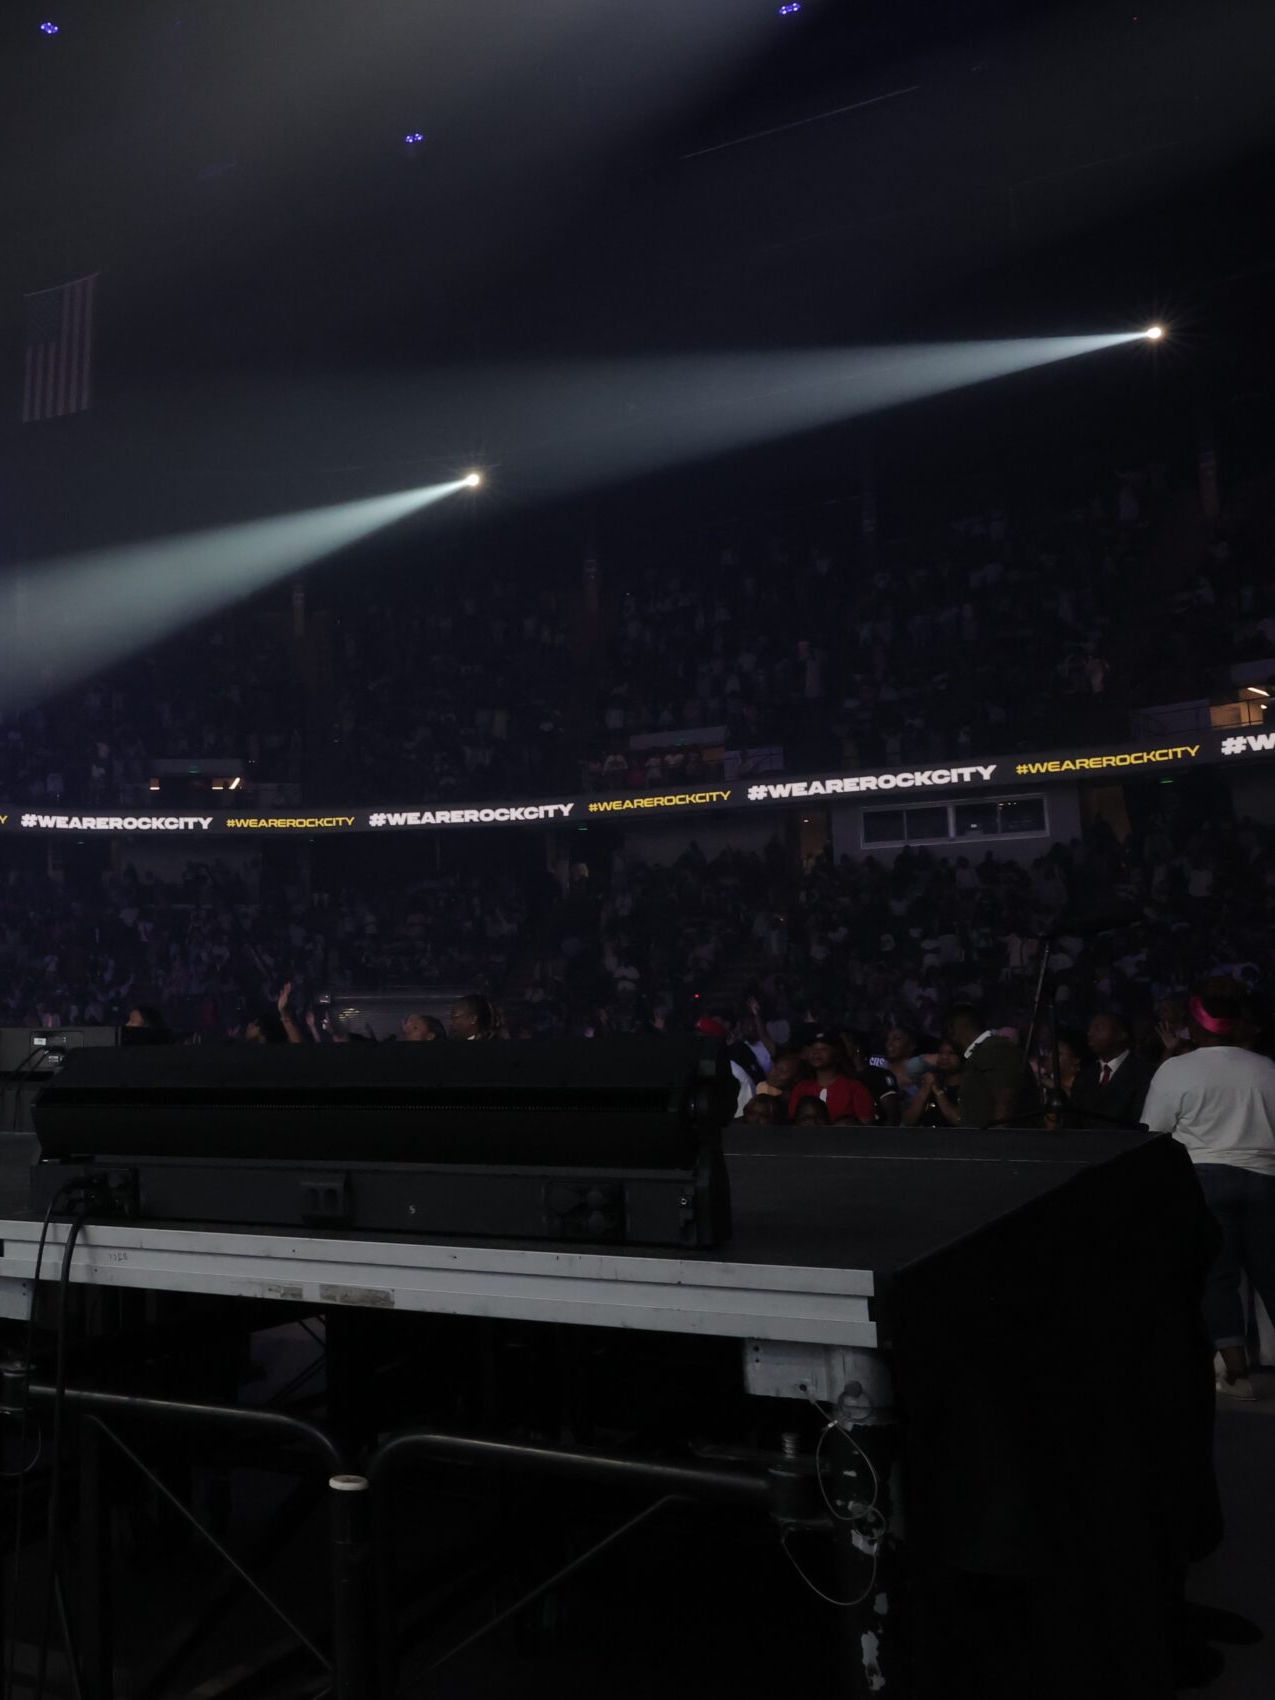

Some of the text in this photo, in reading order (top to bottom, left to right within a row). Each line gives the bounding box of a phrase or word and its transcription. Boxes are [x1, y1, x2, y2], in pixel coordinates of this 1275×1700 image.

[1015, 745, 1200, 775] #WEAREROCKCITY
[747, 764, 997, 801] #WEAREROCKCITY
[588, 791, 731, 813] #WEAREROCKCITY
[21, 813, 213, 830] #WEAREROCKCITY
[227, 816, 355, 828] #WEAREROCKCITY
[369, 803, 574, 827] #WEAREROCKCITY
